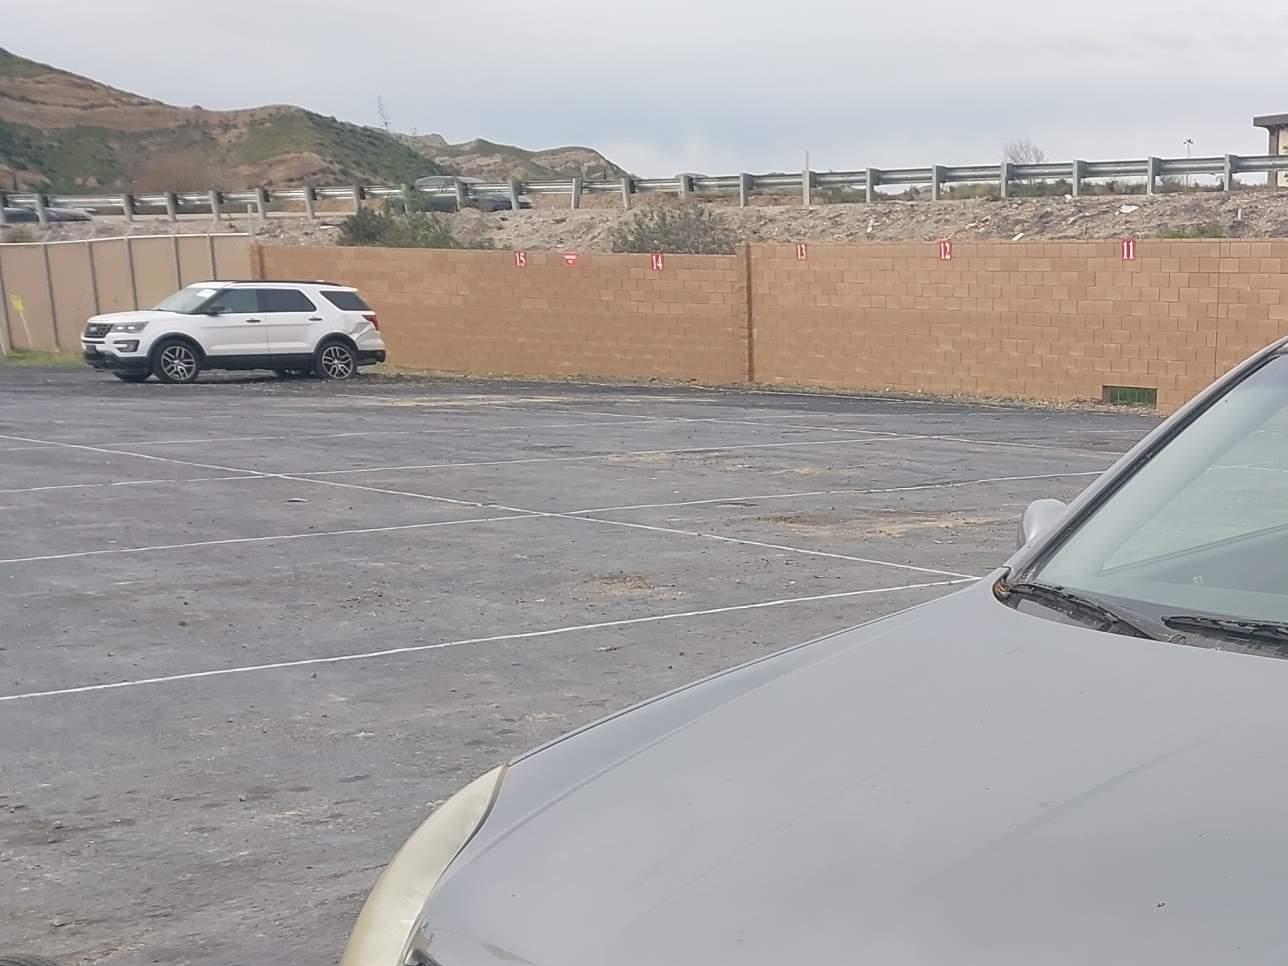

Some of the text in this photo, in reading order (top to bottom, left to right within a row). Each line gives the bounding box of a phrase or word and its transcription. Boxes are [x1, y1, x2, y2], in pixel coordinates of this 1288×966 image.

[796, 243, 806, 260] 13
[940, 242, 950, 259] 12
[1122, 241, 1135, 260] 11
[515, 252, 526, 267] 15
[652, 254, 663, 270] 14
